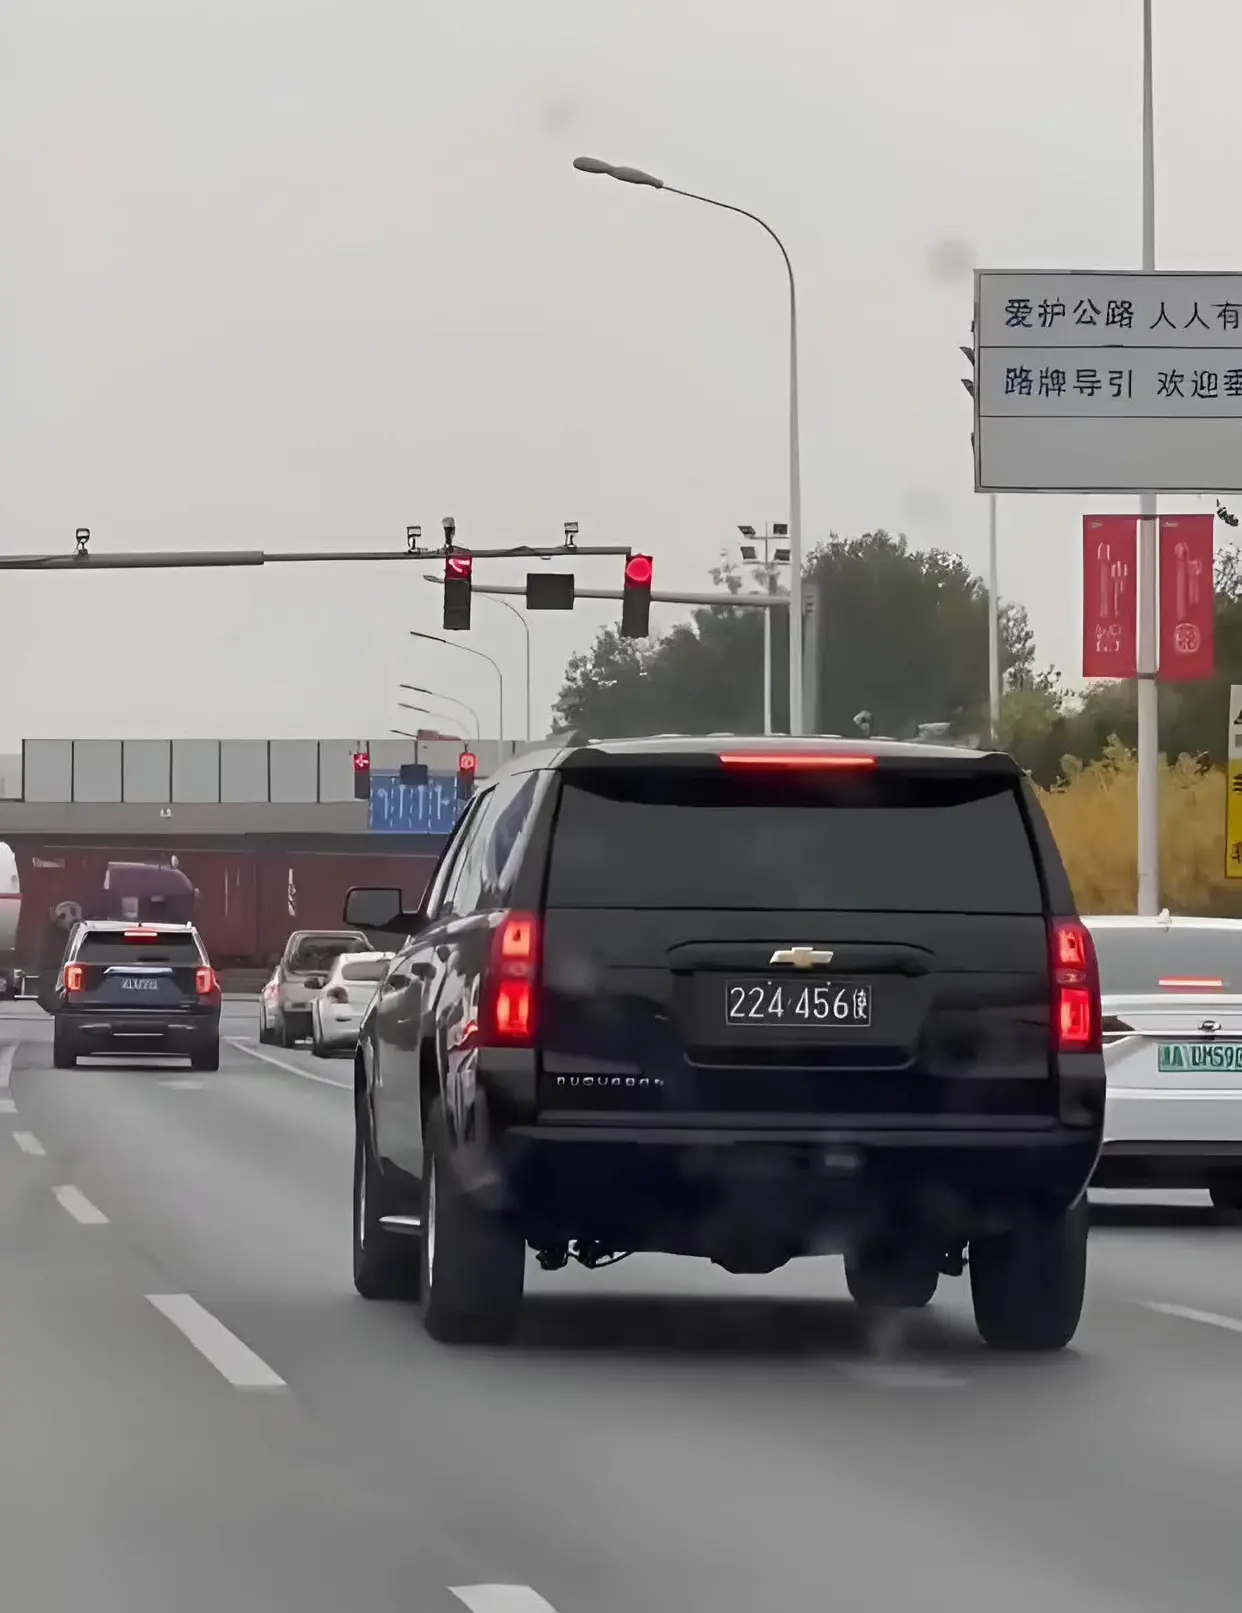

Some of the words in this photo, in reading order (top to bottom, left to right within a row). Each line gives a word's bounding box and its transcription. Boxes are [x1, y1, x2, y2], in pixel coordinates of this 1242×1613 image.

[1004, 297, 1134, 329] 爱护公路
[1150, 300, 1242, 331] 人人有
[1004, 365, 1133, 398] 路牌导引
